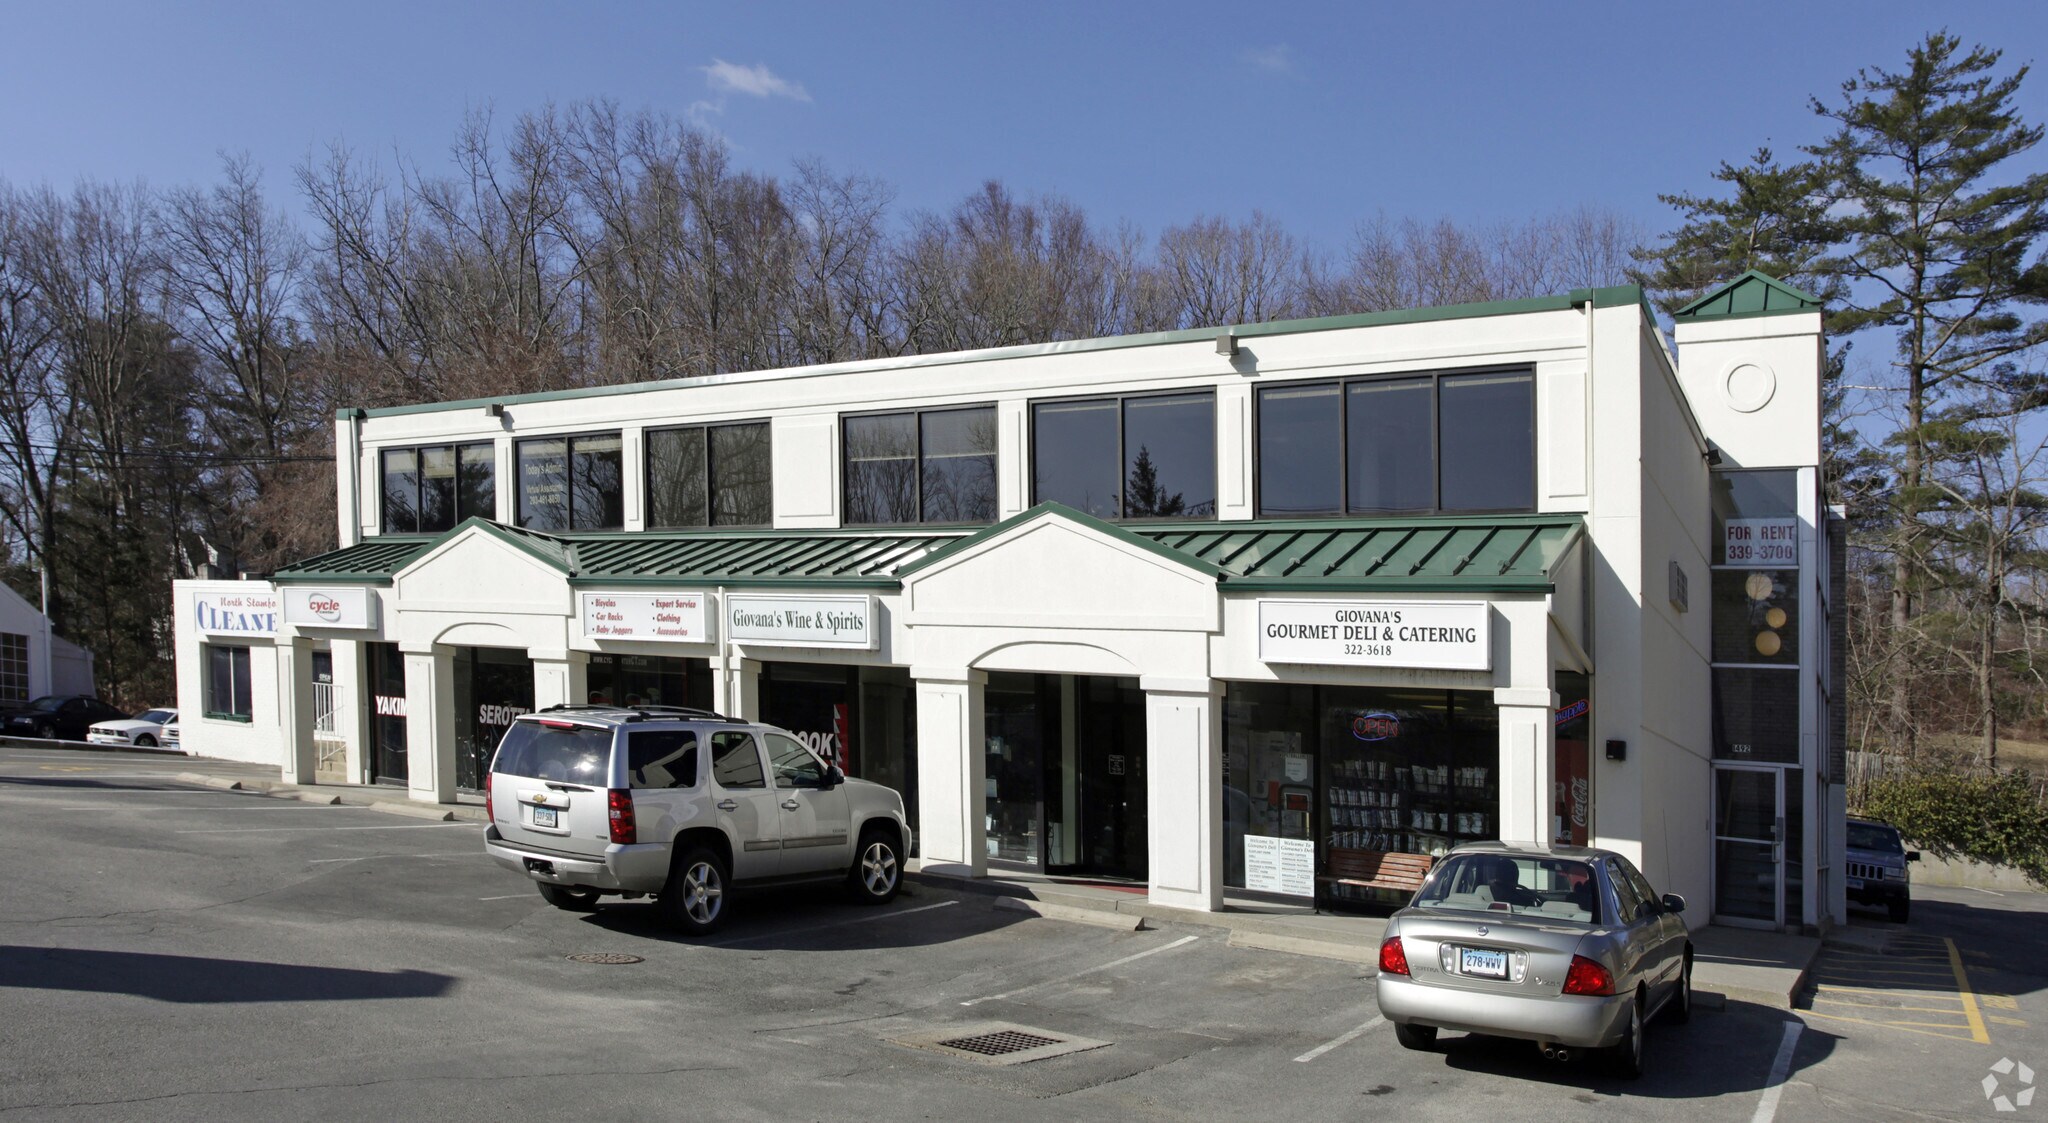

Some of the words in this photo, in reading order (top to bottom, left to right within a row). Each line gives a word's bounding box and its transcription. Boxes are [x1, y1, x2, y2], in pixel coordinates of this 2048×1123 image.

[525, 464, 544, 478] Today's
[1728, 526, 1752, 540] FOR
[1761, 526, 1794, 540] RENT
[1729, 545, 1793, 559] 339-3700
[220, 597, 242, 607] North
[309, 599, 340, 613] cycle
[595, 599, 616, 609] Bicycles
[656, 599, 674, 610] Expert
[675, 599, 697, 609] Service
[197, 600, 278, 633] CLEANE
[596, 612, 606, 621] Car
[607, 612, 623, 621] Racks
[656, 613, 681, 624] Clothing
[733, 609, 782, 628] Giovana's
[785, 610, 812, 629] Wine
[815, 611, 824, 629] &
[826, 611, 864, 635] Spirits
[1335, 610, 1402, 623] GIOVANA'S
[596, 625, 610, 635] Baby
[611, 626, 633, 636] Joggers
[656, 626, 688, 636] Accessories
[1267, 624, 1339, 640] GOURMET
[1343, 626, 1377, 641] DELI
[1382, 627, 1394, 641] &
[1399, 627, 1476, 643] CATERING
[1344, 644, 1392, 656] 322-3618
[1354, 717, 1398, 737] OPEN
[787, 730, 834, 756] OOK
[1466, 956, 1502, 969] 278-WWV
